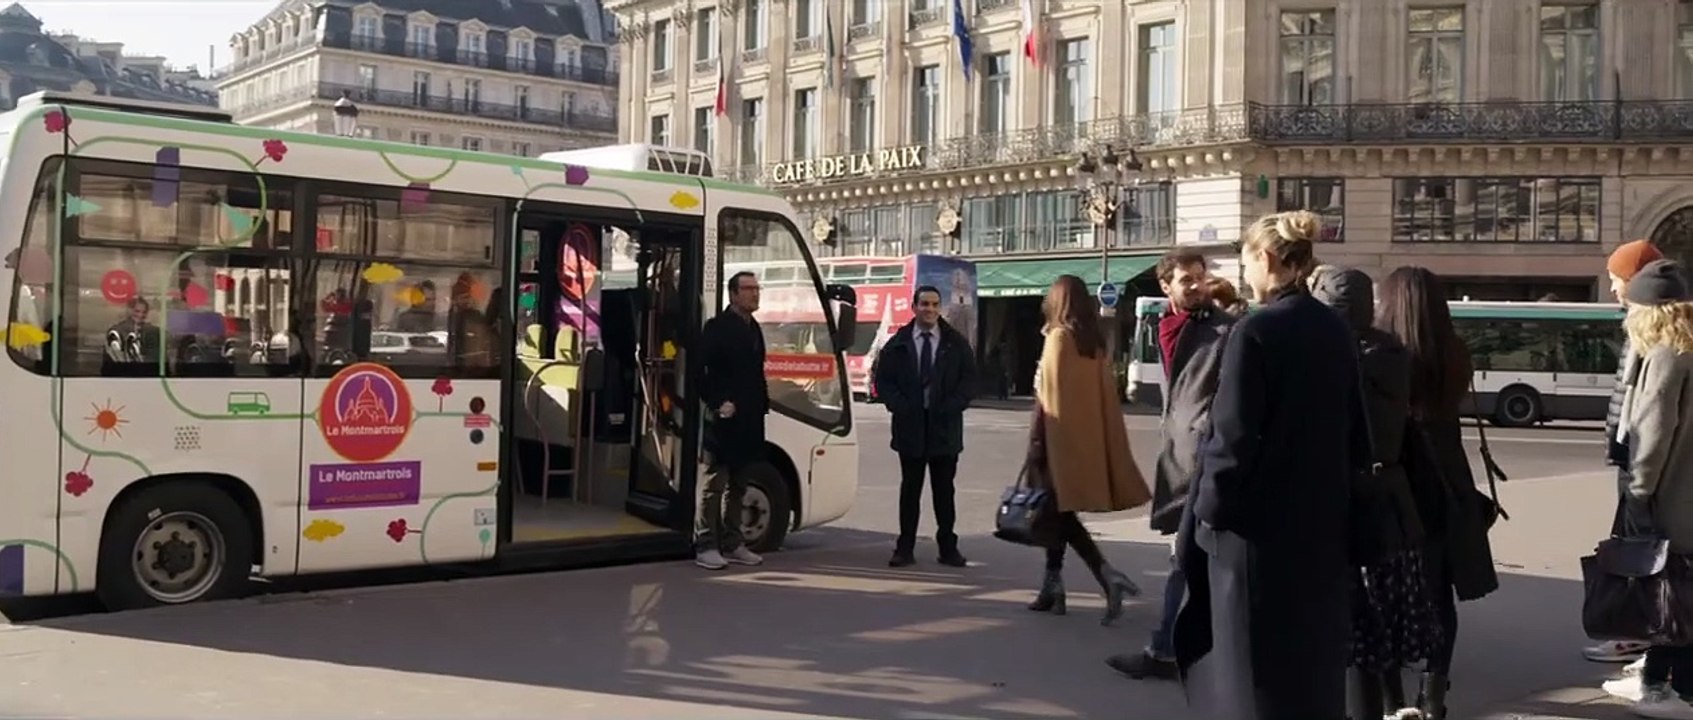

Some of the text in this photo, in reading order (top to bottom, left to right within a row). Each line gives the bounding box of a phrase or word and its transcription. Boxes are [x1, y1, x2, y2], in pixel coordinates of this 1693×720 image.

[822, 157, 845, 177] DE
[850, 153, 873, 174] LA
[880, 145, 922, 170] PAIX
[326, 424, 404, 436] Le Montmartrois
[319, 467, 412, 482] Le Montmartrois
